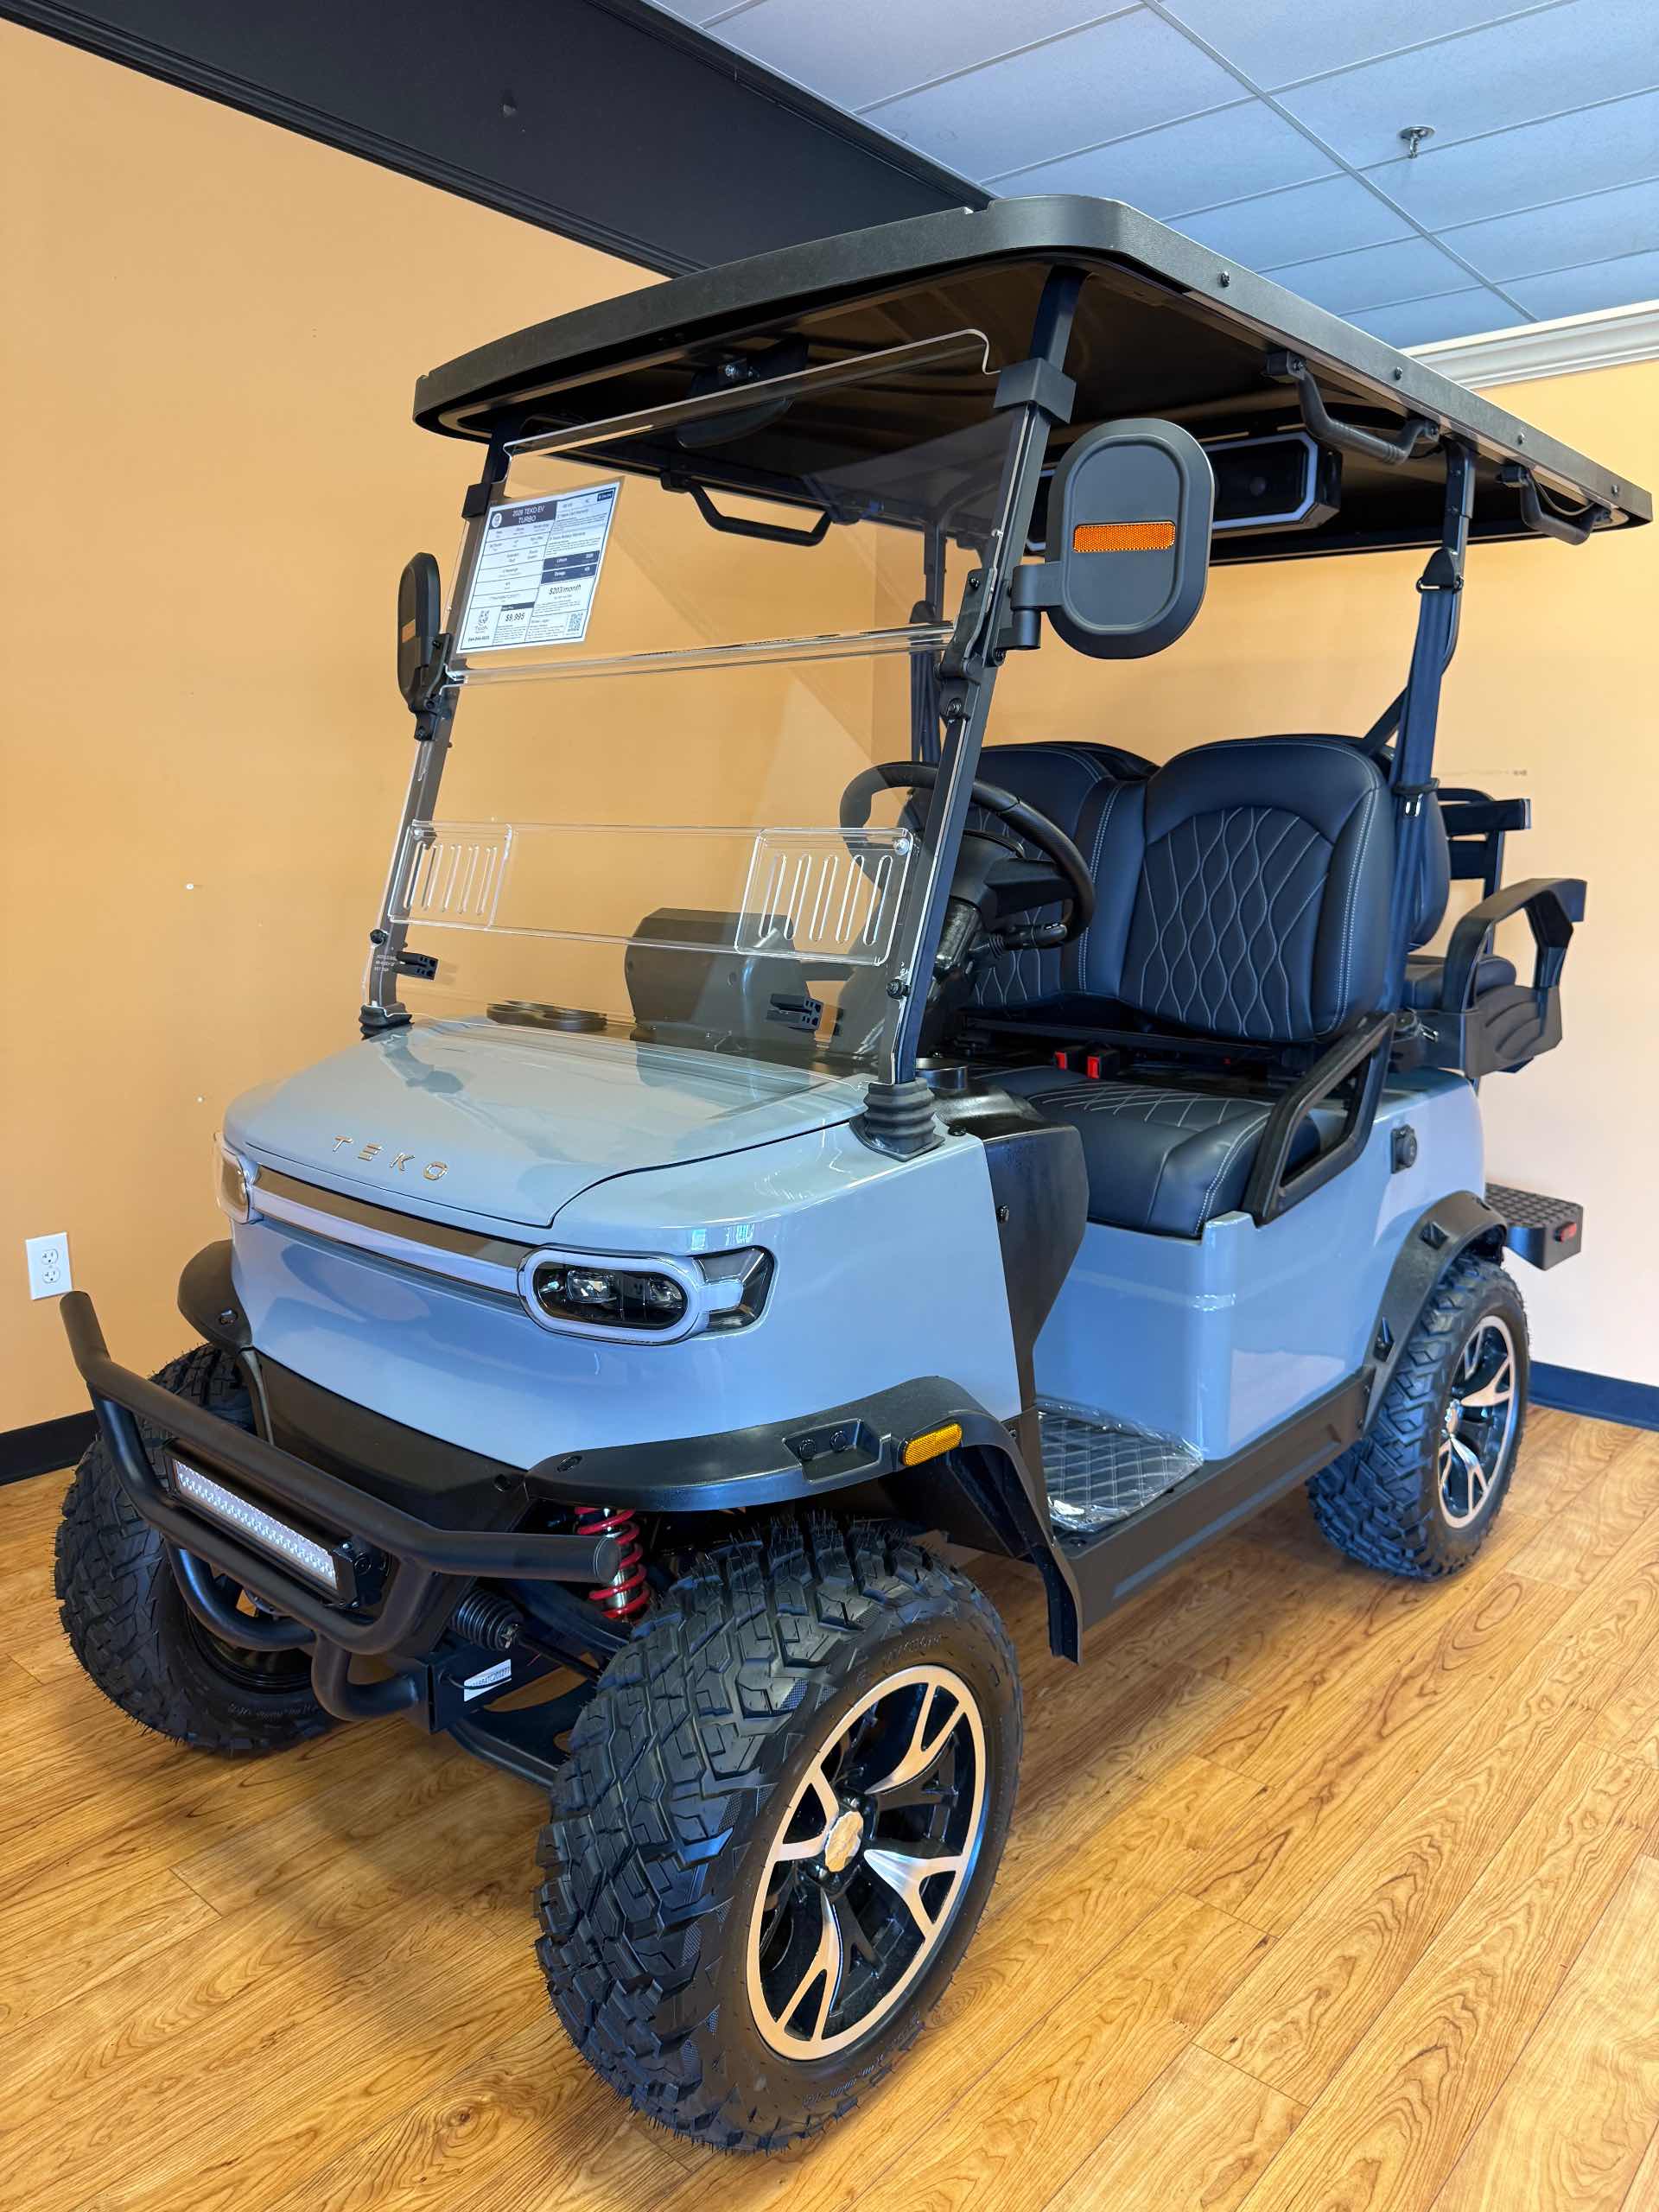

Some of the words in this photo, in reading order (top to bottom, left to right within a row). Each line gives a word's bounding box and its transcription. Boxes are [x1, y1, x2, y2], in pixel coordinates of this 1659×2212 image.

[518, 515, 537, 524] TURBO
[549, 584, 582, 595] $203/month
[505, 612, 525, 622] $9,995
[332, 1135, 448, 1180] TEKO
